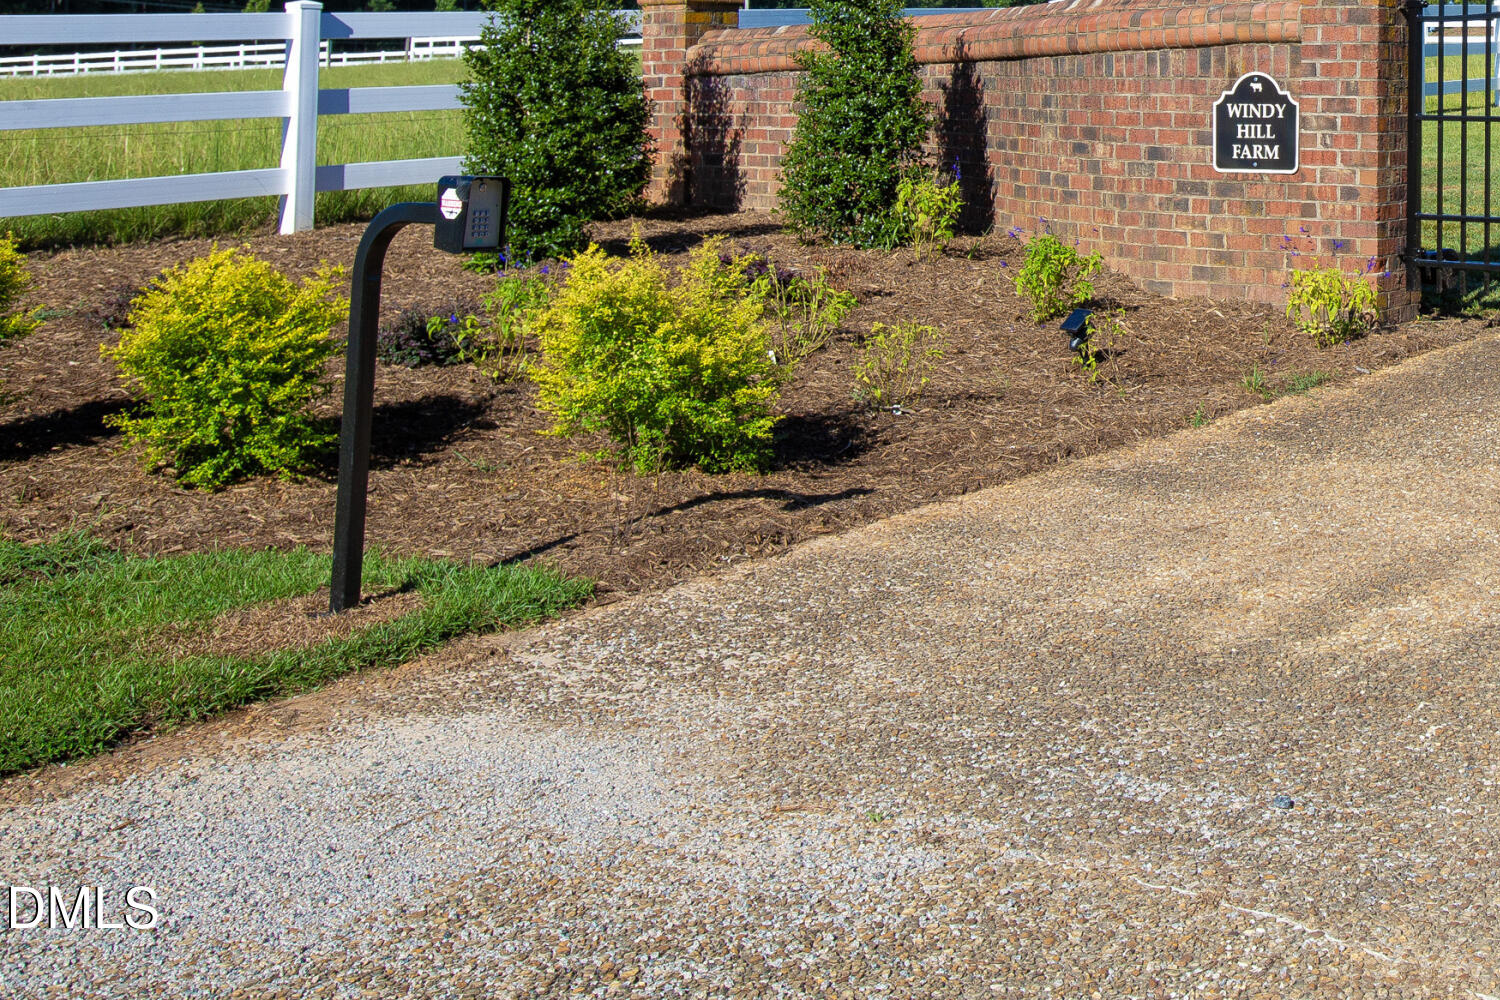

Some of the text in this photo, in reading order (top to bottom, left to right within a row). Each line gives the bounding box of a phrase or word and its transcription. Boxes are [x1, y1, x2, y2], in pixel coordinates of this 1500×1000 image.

[1226, 103, 1286, 118] WINDY
[1236, 124, 1276, 139] HILL
[1232, 144, 1280, 159] FARM
